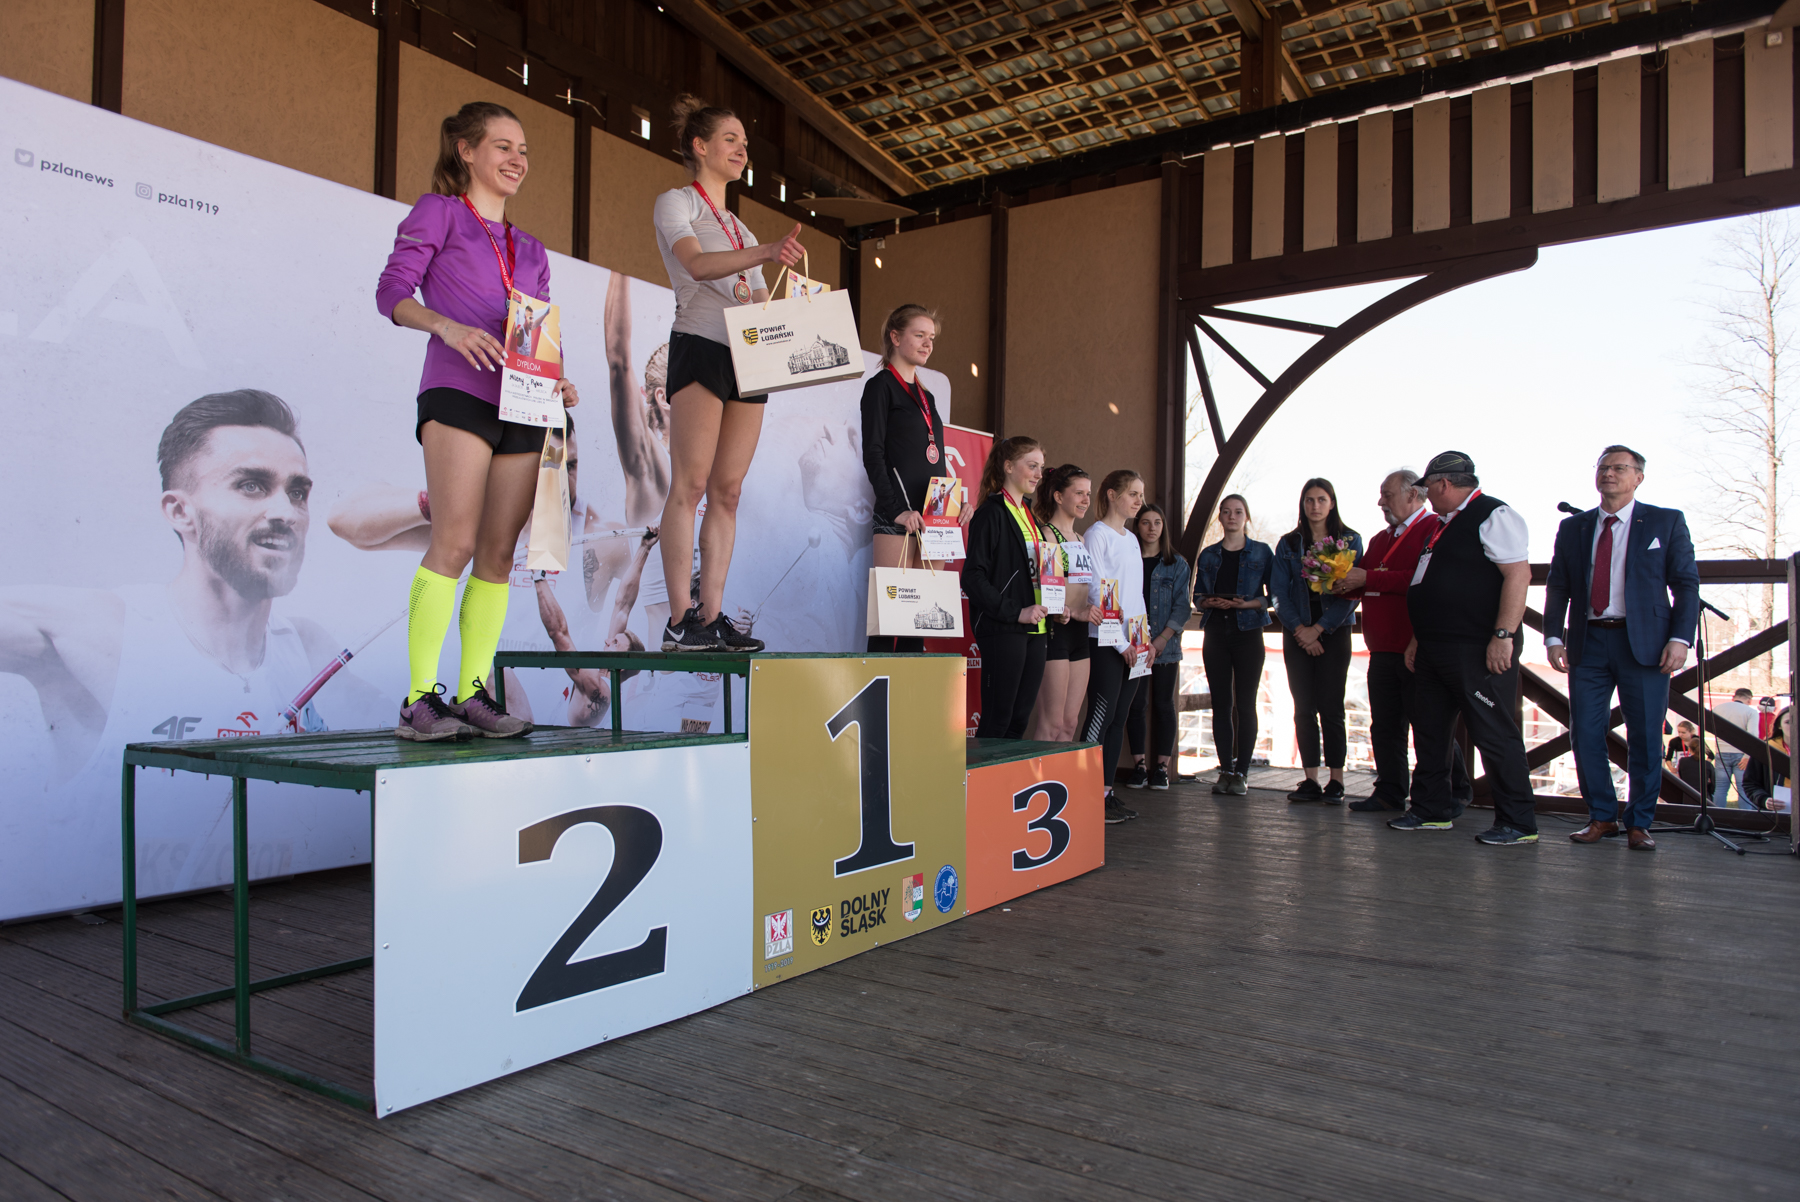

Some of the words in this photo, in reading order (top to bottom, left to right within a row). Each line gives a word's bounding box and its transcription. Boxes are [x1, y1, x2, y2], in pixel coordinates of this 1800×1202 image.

[40, 159, 115, 188] pzlanews
[158, 192, 220, 216] pzla1919
[759, 324, 786, 334] POWIAT
[761, 331, 795, 342] LUBAŃSKI
[517, 359, 542, 373] DYPLOM
[1474, 691, 1495, 708] Reebok
[825, 676, 915, 878] 1
[1012, 780, 1071, 871] 3
[514, 804, 669, 1015] 2
[840, 888, 890, 919] DOLNY
[840, 907, 887, 938] ŚLĄSK
[766, 941, 792, 957] PZLA
[764, 956, 794, 973] 1919-2019
